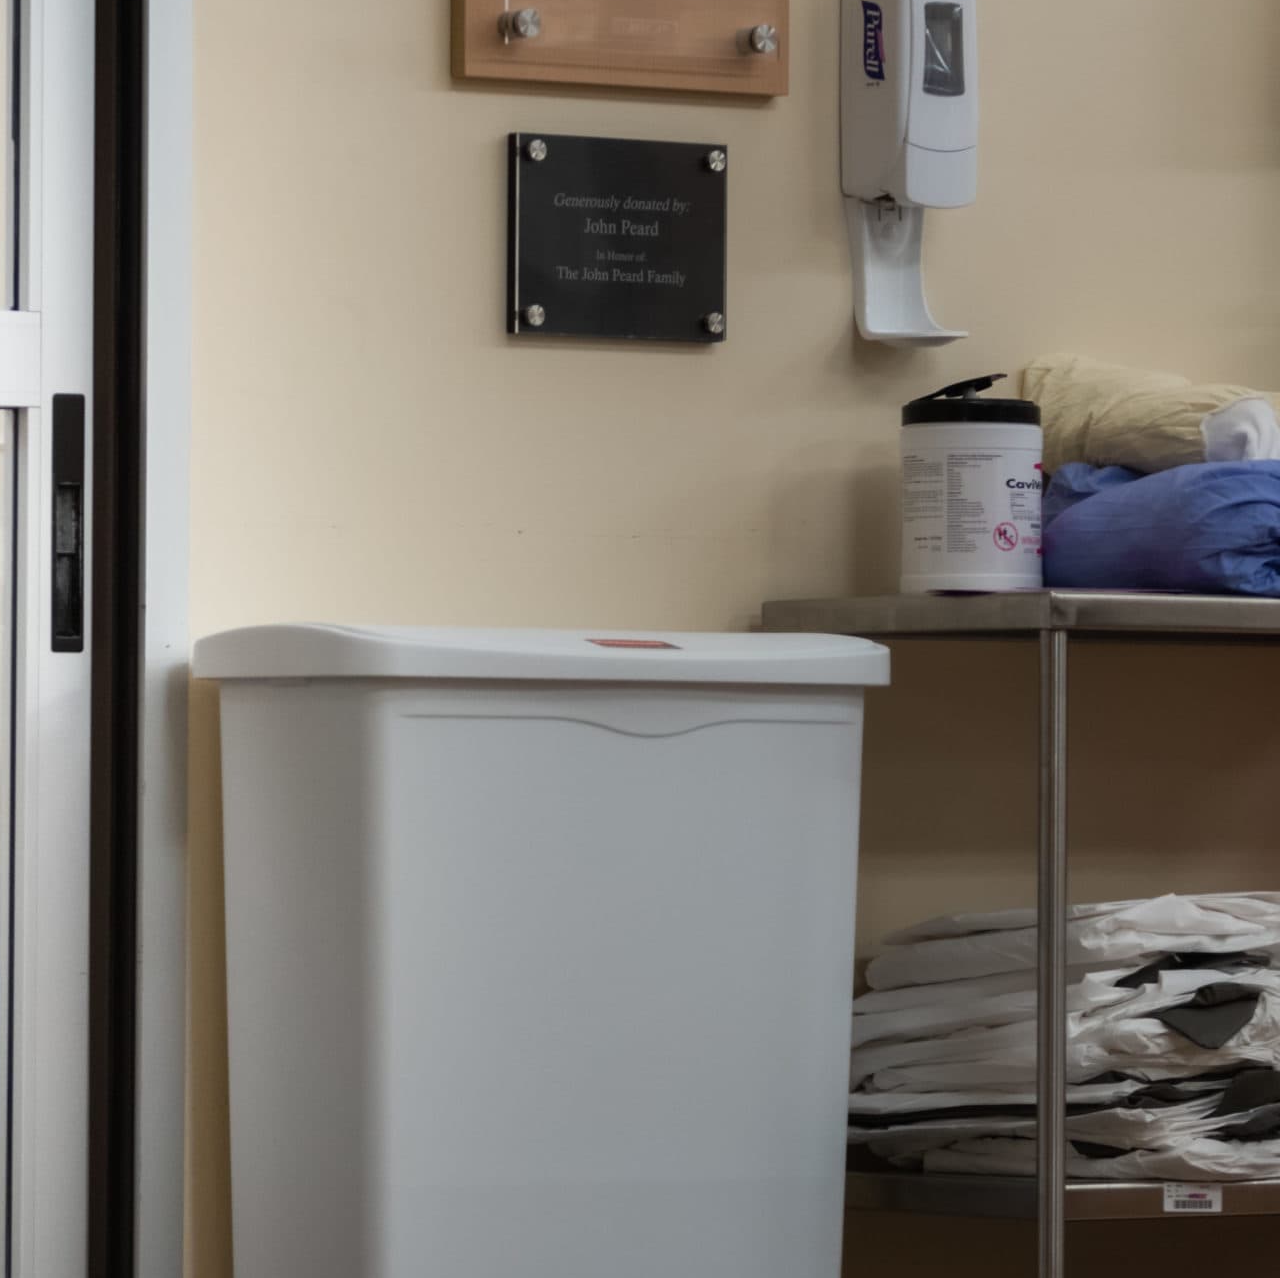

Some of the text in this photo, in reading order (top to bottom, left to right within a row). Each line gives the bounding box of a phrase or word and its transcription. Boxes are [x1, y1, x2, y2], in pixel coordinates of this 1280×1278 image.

[866, 9, 881, 73] Purell
[553, 193, 621, 212] Generously
[623, 196, 670, 212] donated
[583, 218, 659, 237] John Peard
[556, 266, 686, 287] The John Peard Family
